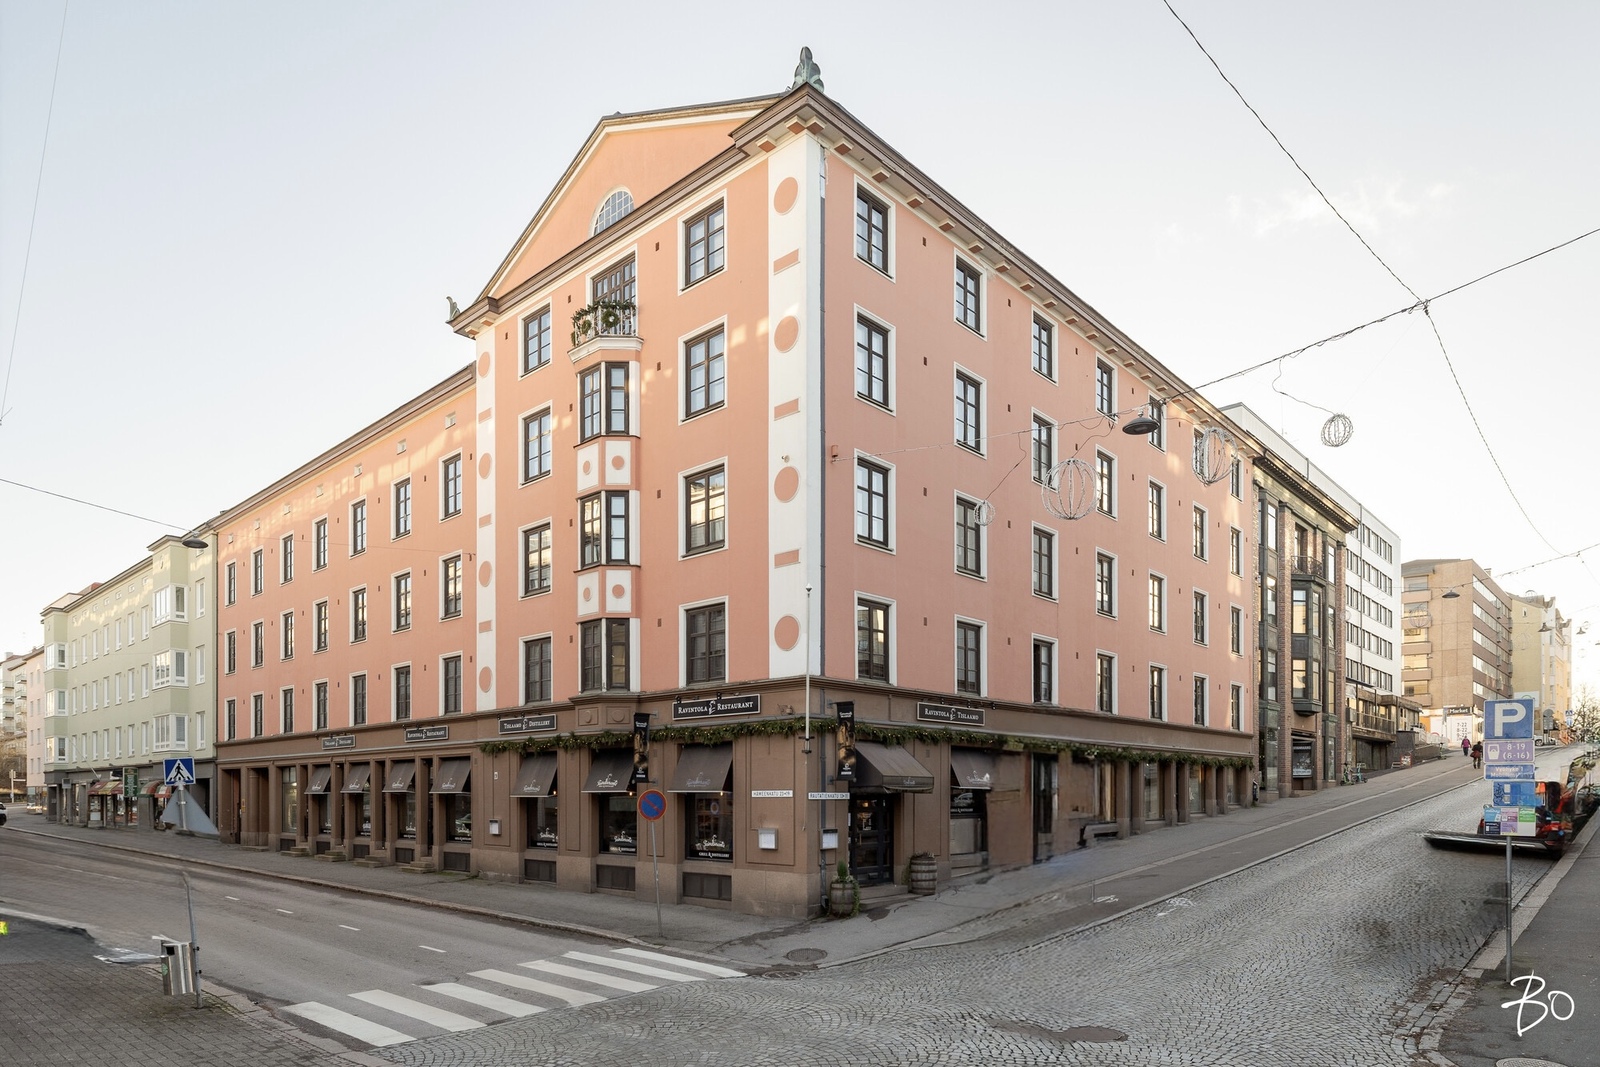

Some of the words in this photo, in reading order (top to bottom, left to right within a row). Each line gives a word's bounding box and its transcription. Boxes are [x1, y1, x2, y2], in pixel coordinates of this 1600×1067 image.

[678, 706, 708, 714] RAVINTOLA
[717, 702, 754, 710] RESTAURANT
[924, 708, 950, 717] RAVINTOLA
[957, 712, 979, 720] TISLAAMO
[1494, 702, 1526, 736] P
